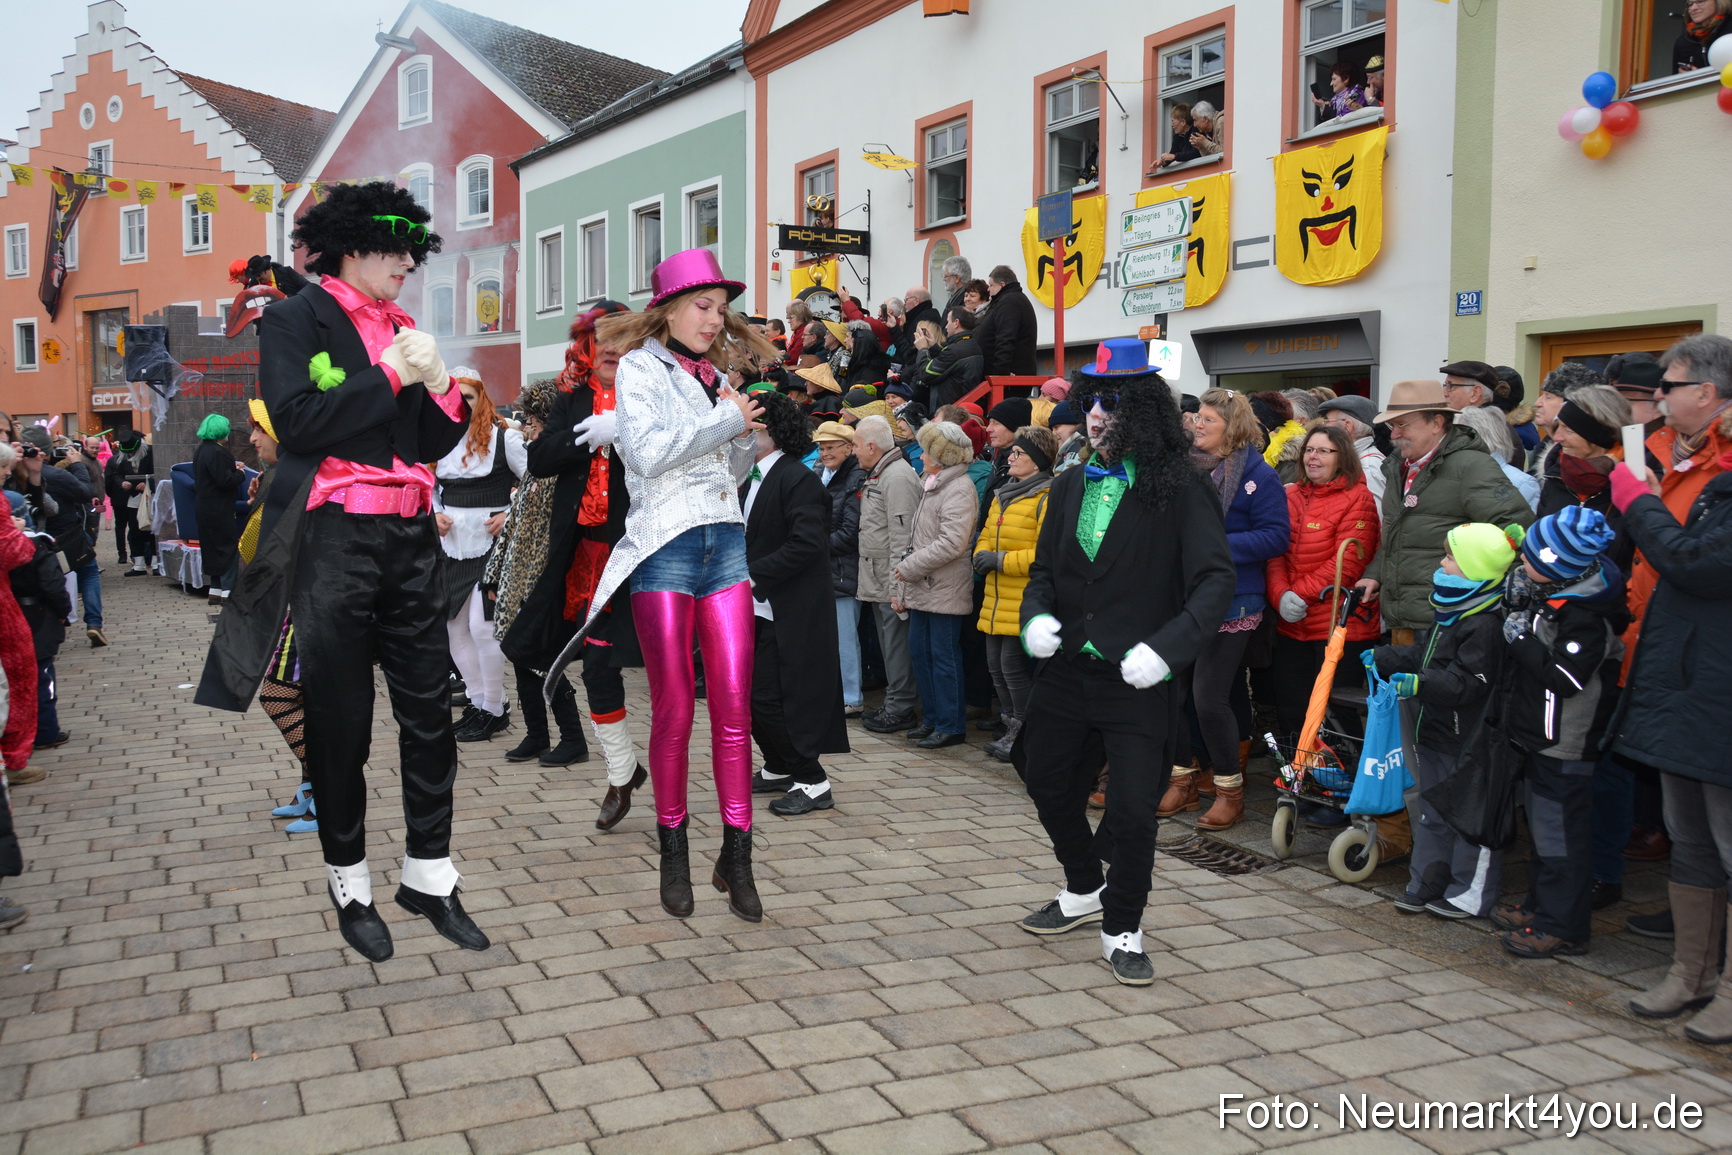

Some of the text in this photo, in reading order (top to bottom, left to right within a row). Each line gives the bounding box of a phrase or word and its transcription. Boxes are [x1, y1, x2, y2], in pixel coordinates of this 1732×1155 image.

[1134, 211, 1161, 224] Beilngries
[788, 229, 861, 245] RÖHLICH
[1134, 230, 1152, 240] Töging
[1132, 251, 1161, 263] Riedenburg
[1131, 268, 1156, 280] Mühlbach
[1132, 291, 1153, 301] Parsberg
[1459, 292, 1477, 306] 20
[1132, 302, 1161, 313] Breitenbrunn
[1265, 334, 1339, 355] UHREN
[92, 392, 132, 406] GÖTZ
